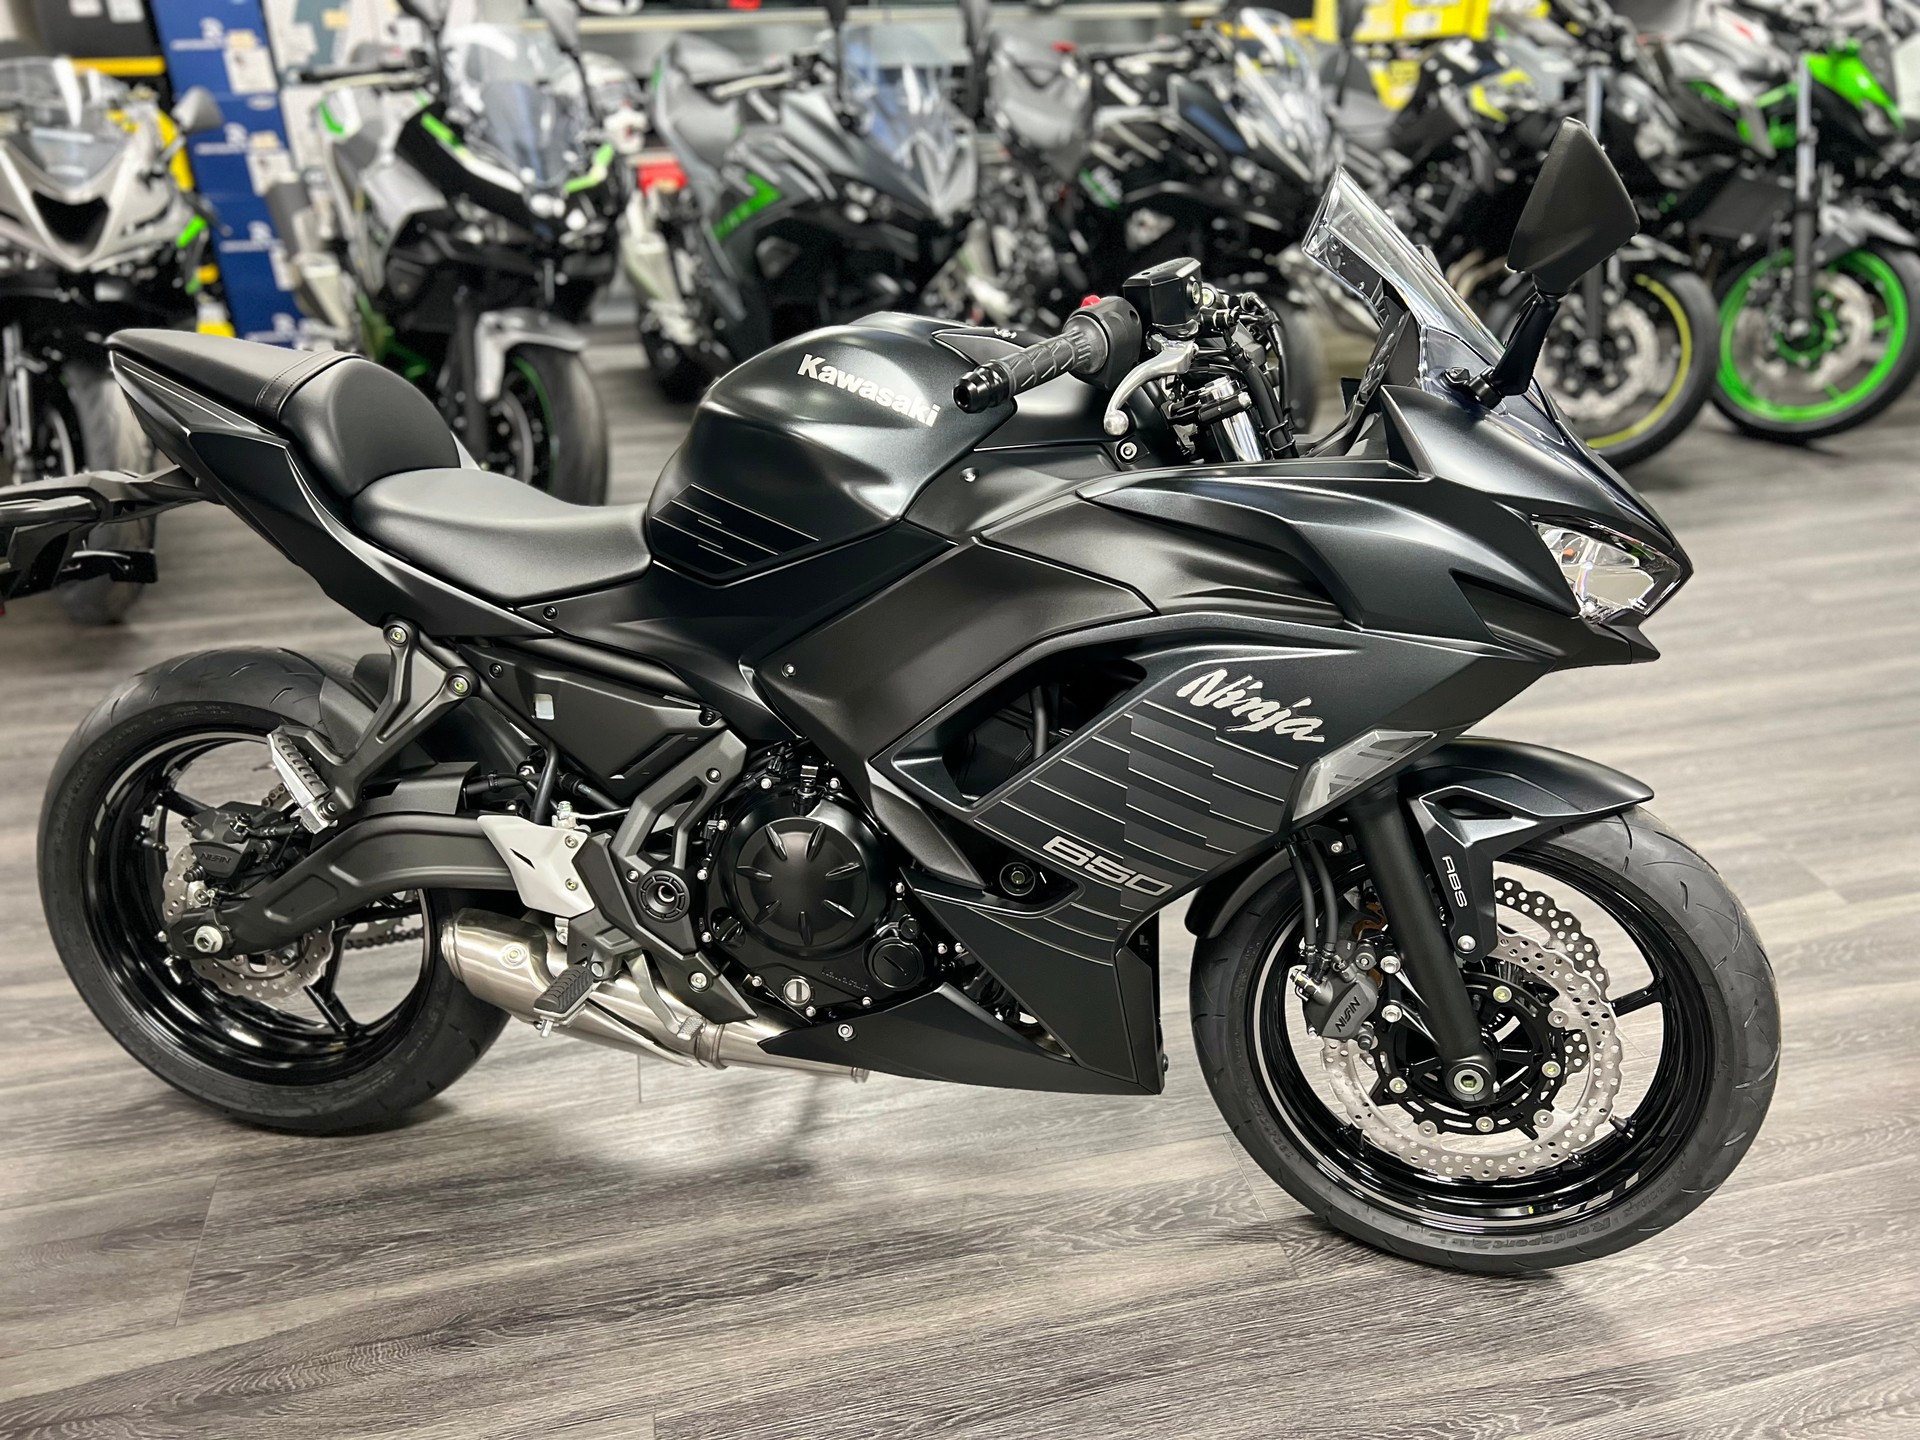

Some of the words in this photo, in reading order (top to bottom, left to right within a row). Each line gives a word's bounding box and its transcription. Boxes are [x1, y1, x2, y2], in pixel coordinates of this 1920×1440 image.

[797, 353, 941, 428] Kawasaki
[1176, 668, 1326, 743] Ninja
[1042, 835, 1173, 897] 650
[1441, 855, 1468, 908] ABS
[1335, 995, 1361, 1033] NISSIN
